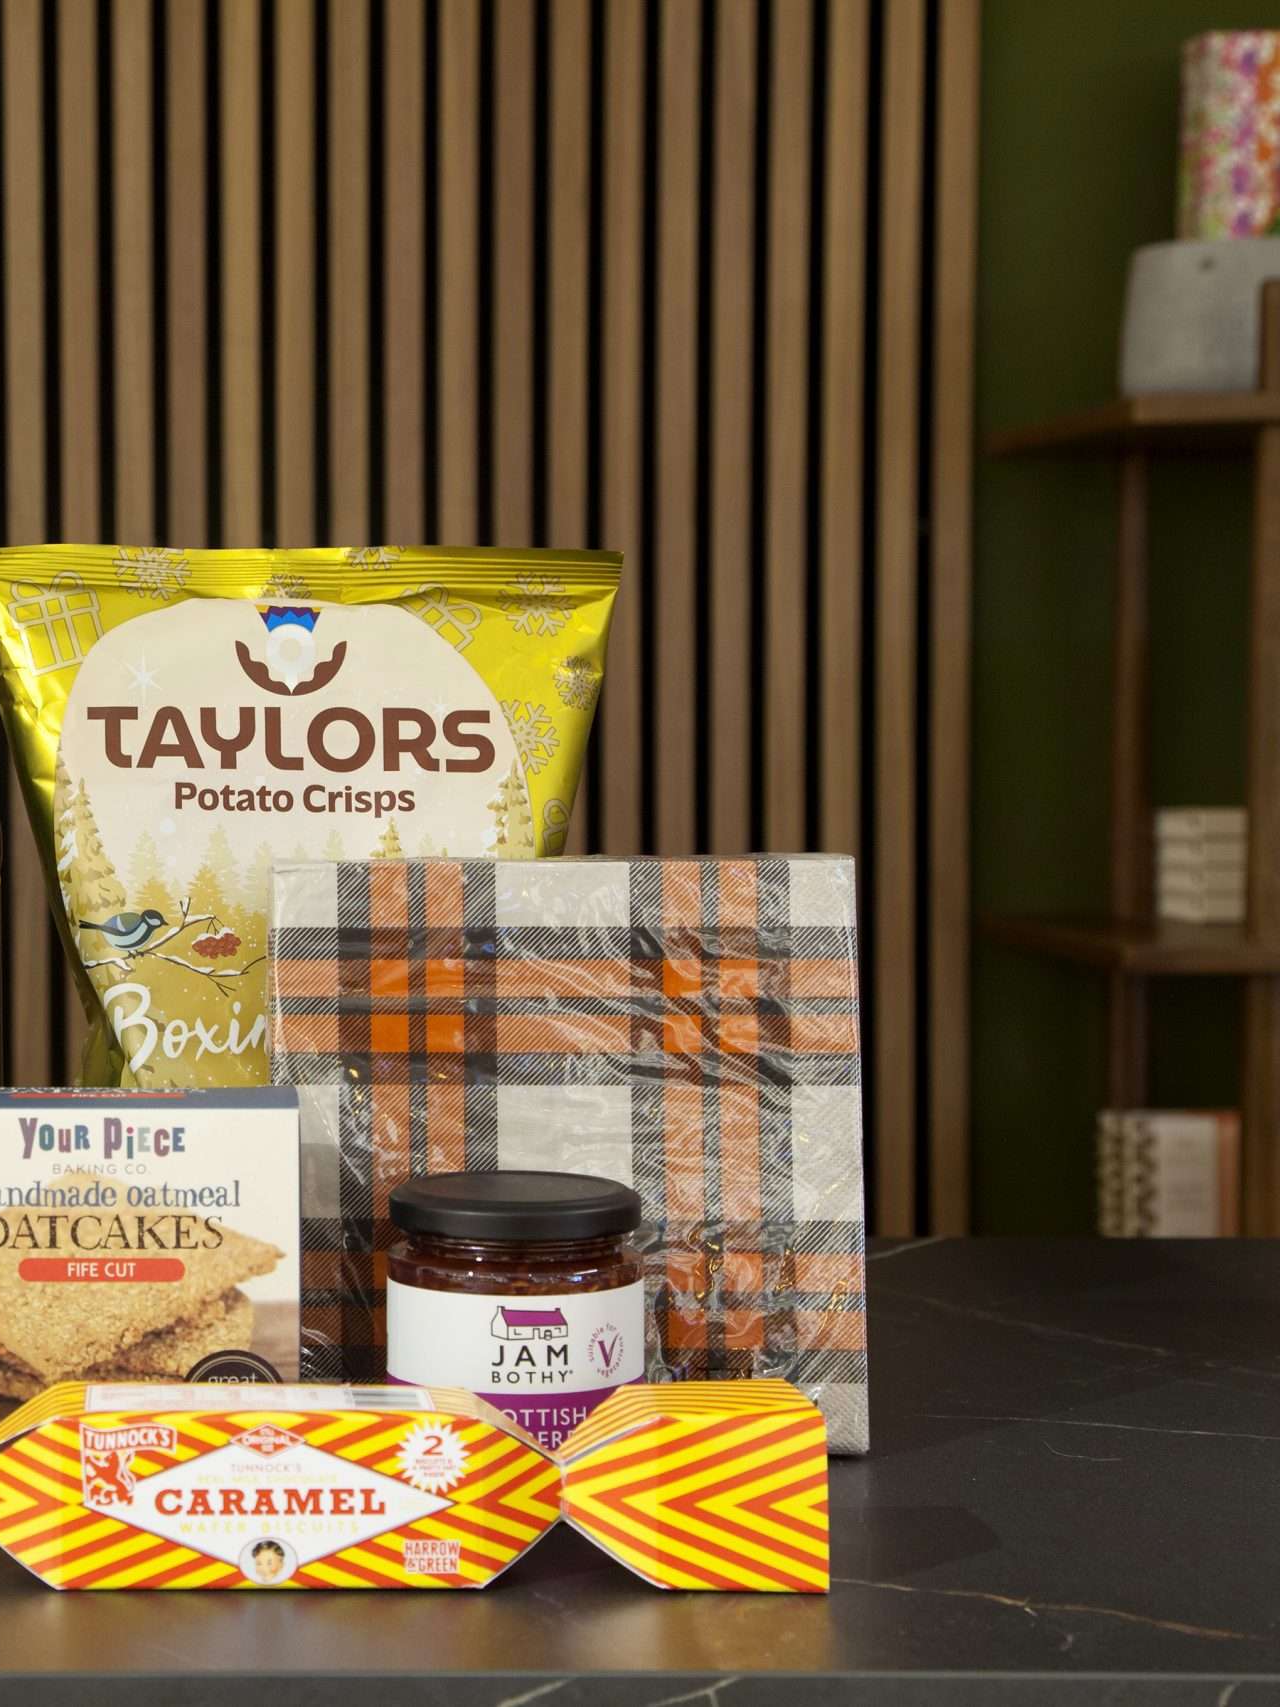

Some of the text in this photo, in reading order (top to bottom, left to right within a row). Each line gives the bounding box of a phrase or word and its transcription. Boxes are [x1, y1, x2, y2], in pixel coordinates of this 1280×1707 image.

[87, 705, 496, 774] TAYLORS
[174, 781, 417, 819] Potato Crisps
[52, 1164, 117, 1175] BAKING
[126, 1180, 240, 1208] oatmeal
[67, 1262, 136, 1278] FIFE CUT
[491, 1344, 568, 1367] JAM
[491, 1370, 570, 1383] BOTHY
[84, 1428, 171, 1450] TUNNOCK'S
[423, 1435, 443, 1455] 2
[154, 1488, 387, 1516] CARAMEL
[405, 1542, 459, 1555] HARROW
[407, 1558, 458, 1572] & GREEN
